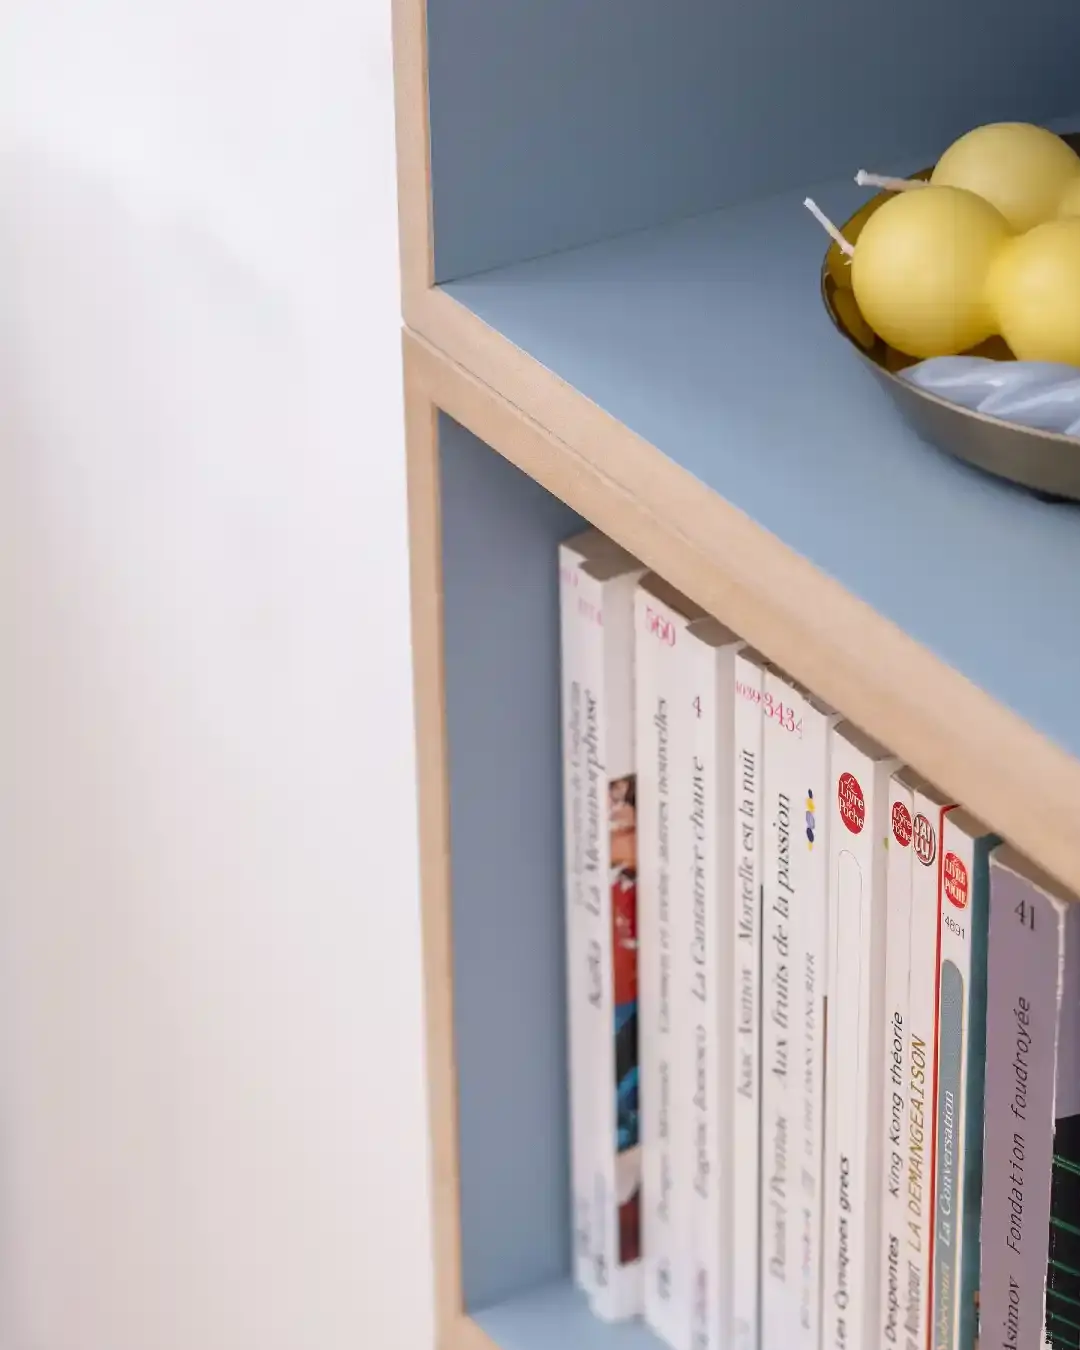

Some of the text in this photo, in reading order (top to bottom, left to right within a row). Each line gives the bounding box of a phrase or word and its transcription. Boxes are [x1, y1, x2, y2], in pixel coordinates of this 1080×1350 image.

[739, 749, 755, 794] nuit
[840, 781, 864, 810] Livre
[738, 799, 754, 818] la
[840, 798, 864, 829] Poche
[741, 822, 754, 853] est
[771, 792, 794, 895] passion
[737, 857, 754, 946] Mortelle
[771, 896, 789, 920] la
[1014, 901, 1035, 931] 41
[771, 923, 789, 957] de
[771, 961, 789, 1030] fruits
[771, 1037, 788, 1086] Aux
[890, 1011, 904, 1086] théorie
[1012, 996, 1032, 1125] foudroyée
[889, 1091, 905, 1144] Kong
[908, 1034, 927, 1218] DEMANGEAISON
[888, 1148, 903, 1198] King
[938, 1089, 955, 1216] Conversation
[840, 1155, 851, 1212] grecs
[1006, 1134, 1026, 1255] Fondation
[908, 1222, 922, 1254] LA
[938, 1223, 950, 1248] La
[886, 1235, 902, 1347] Despentes
